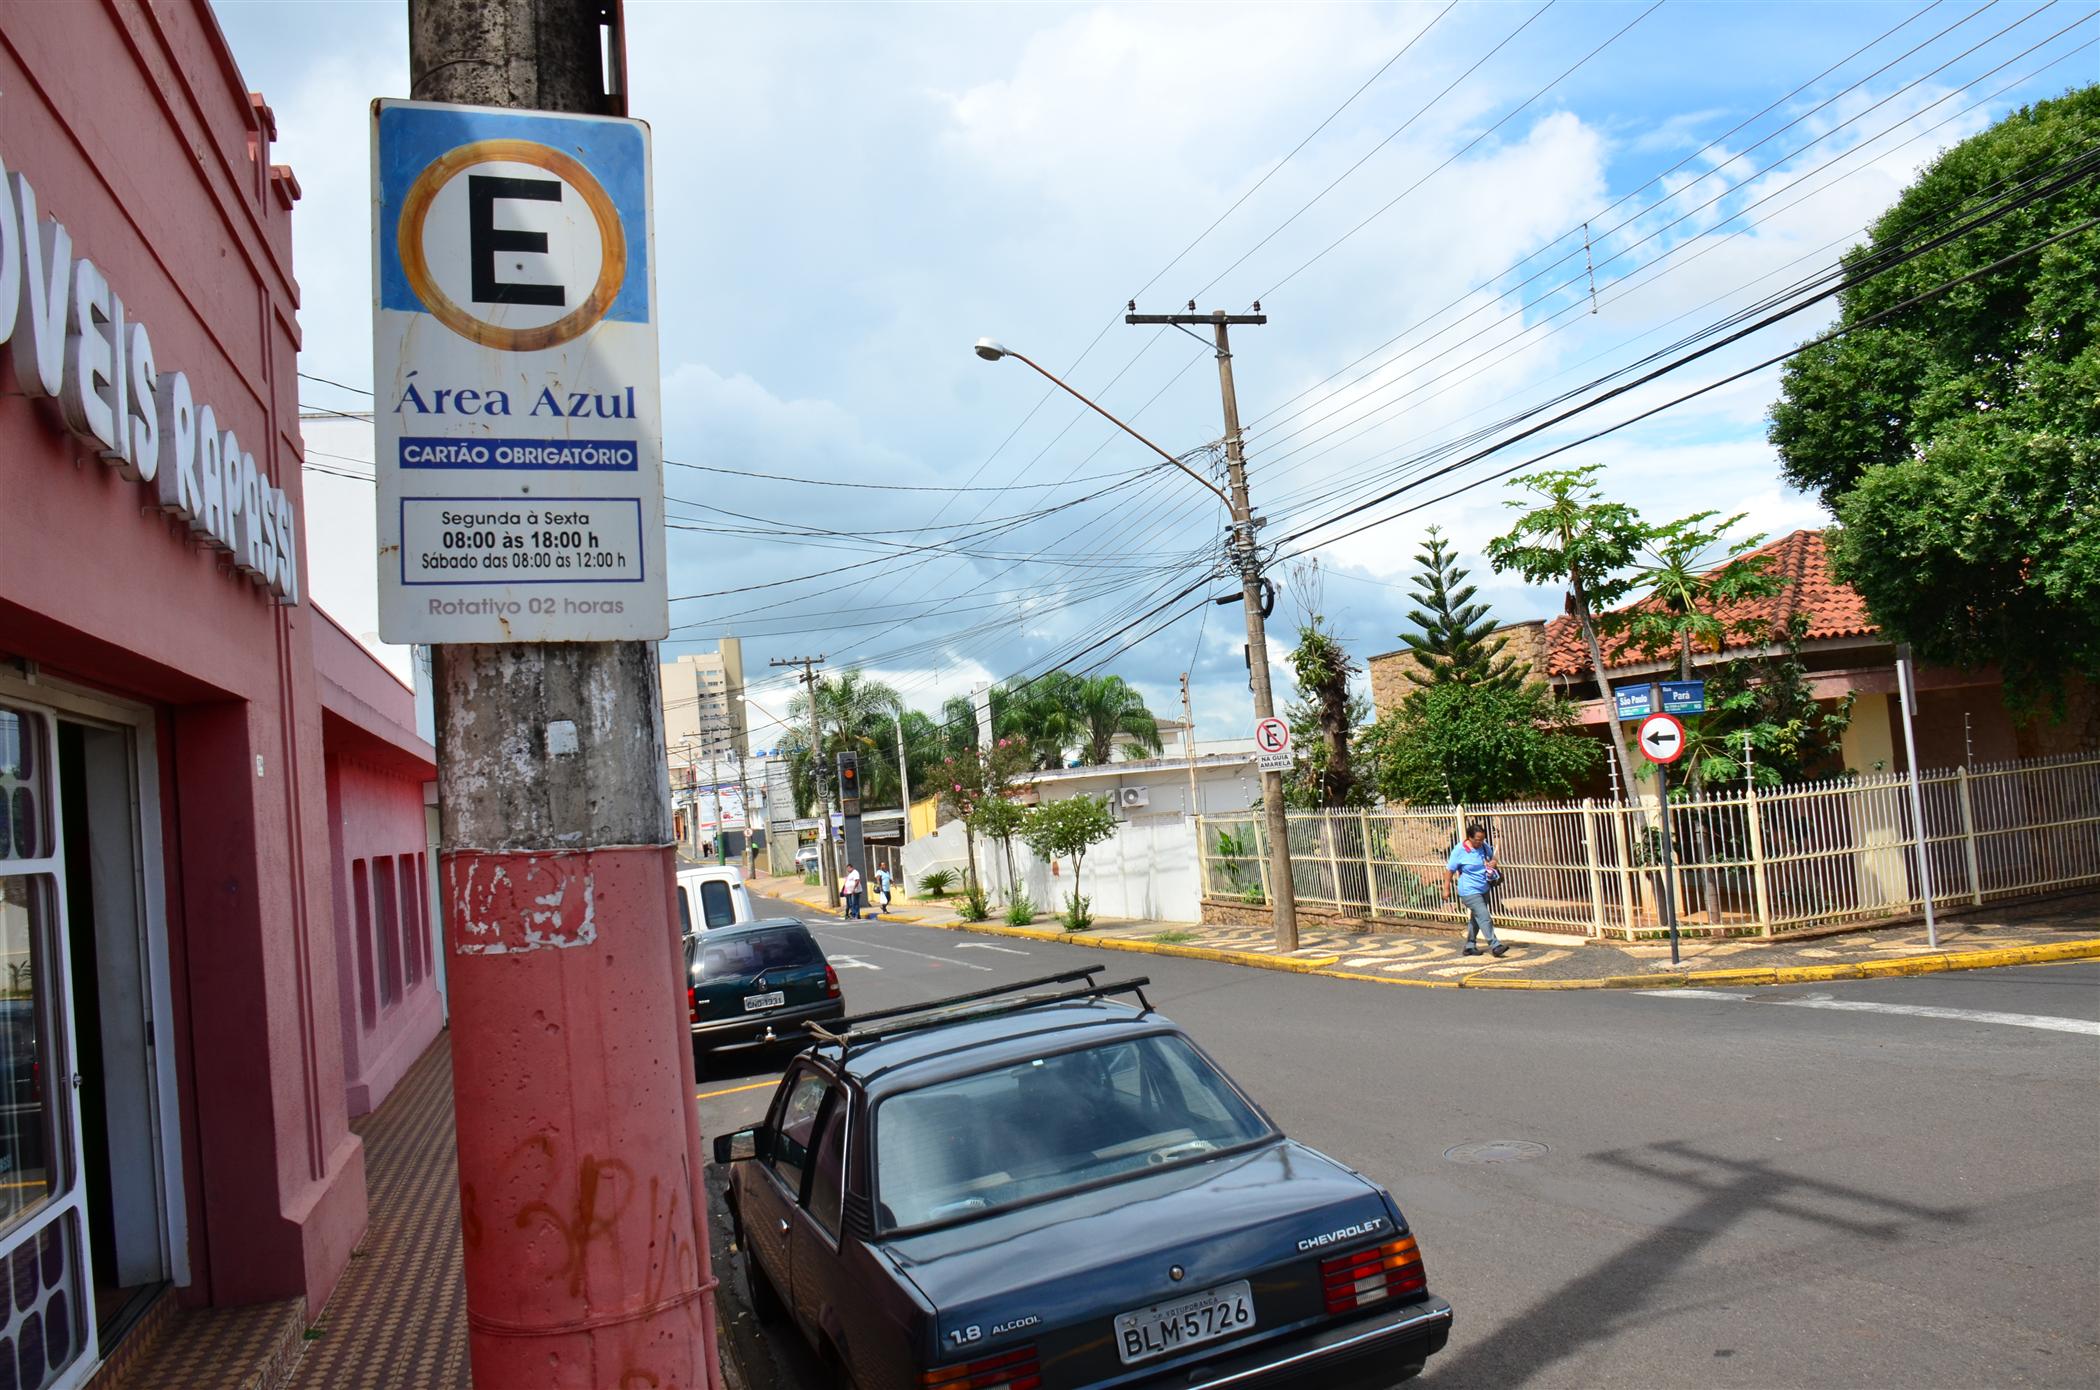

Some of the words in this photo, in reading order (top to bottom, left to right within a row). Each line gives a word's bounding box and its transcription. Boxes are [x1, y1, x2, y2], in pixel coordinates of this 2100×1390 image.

[468, 174, 566, 307] E
[393, 370, 512, 417] Área
[530, 386, 637, 420] Azul
[403, 442, 489, 465] CARTÃO
[495, 444, 633, 466] OBRIGATÓRIO
[159, 371, 298, 607] RAPASSI
[441, 511, 521, 529] Segunda
[527, 510, 538, 525] à
[544, 511, 590, 525] Sexta
[442, 531, 496, 549] 08:00
[503, 531, 524, 549] às
[532, 530, 582, 549] 18:00
[589, 530, 599, 548] h
[421, 551, 478, 570] Sábado
[482, 552, 508, 569] das
[512, 552, 551, 568] 08:00
[555, 551, 571, 568] às
[577, 552, 613, 568] 12:00
[617, 551, 626, 567] h
[428, 597, 521, 616] Rotativo
[528, 597, 556, 615] 02
[564, 597, 624, 615] horas
[1619, 697, 1632, 706] São
[1631, 694, 1648, 705] Paulo
[1672, 691, 1691, 701] Pará
[1265, 724, 1279, 747] E
[1260, 760, 1291, 768] AMARELA
[1297, 1218, 1382, 1251] CHEVROLET
[950, 1325, 982, 1345] 1.8
[992, 1315, 1042, 1335] ALCOOL
